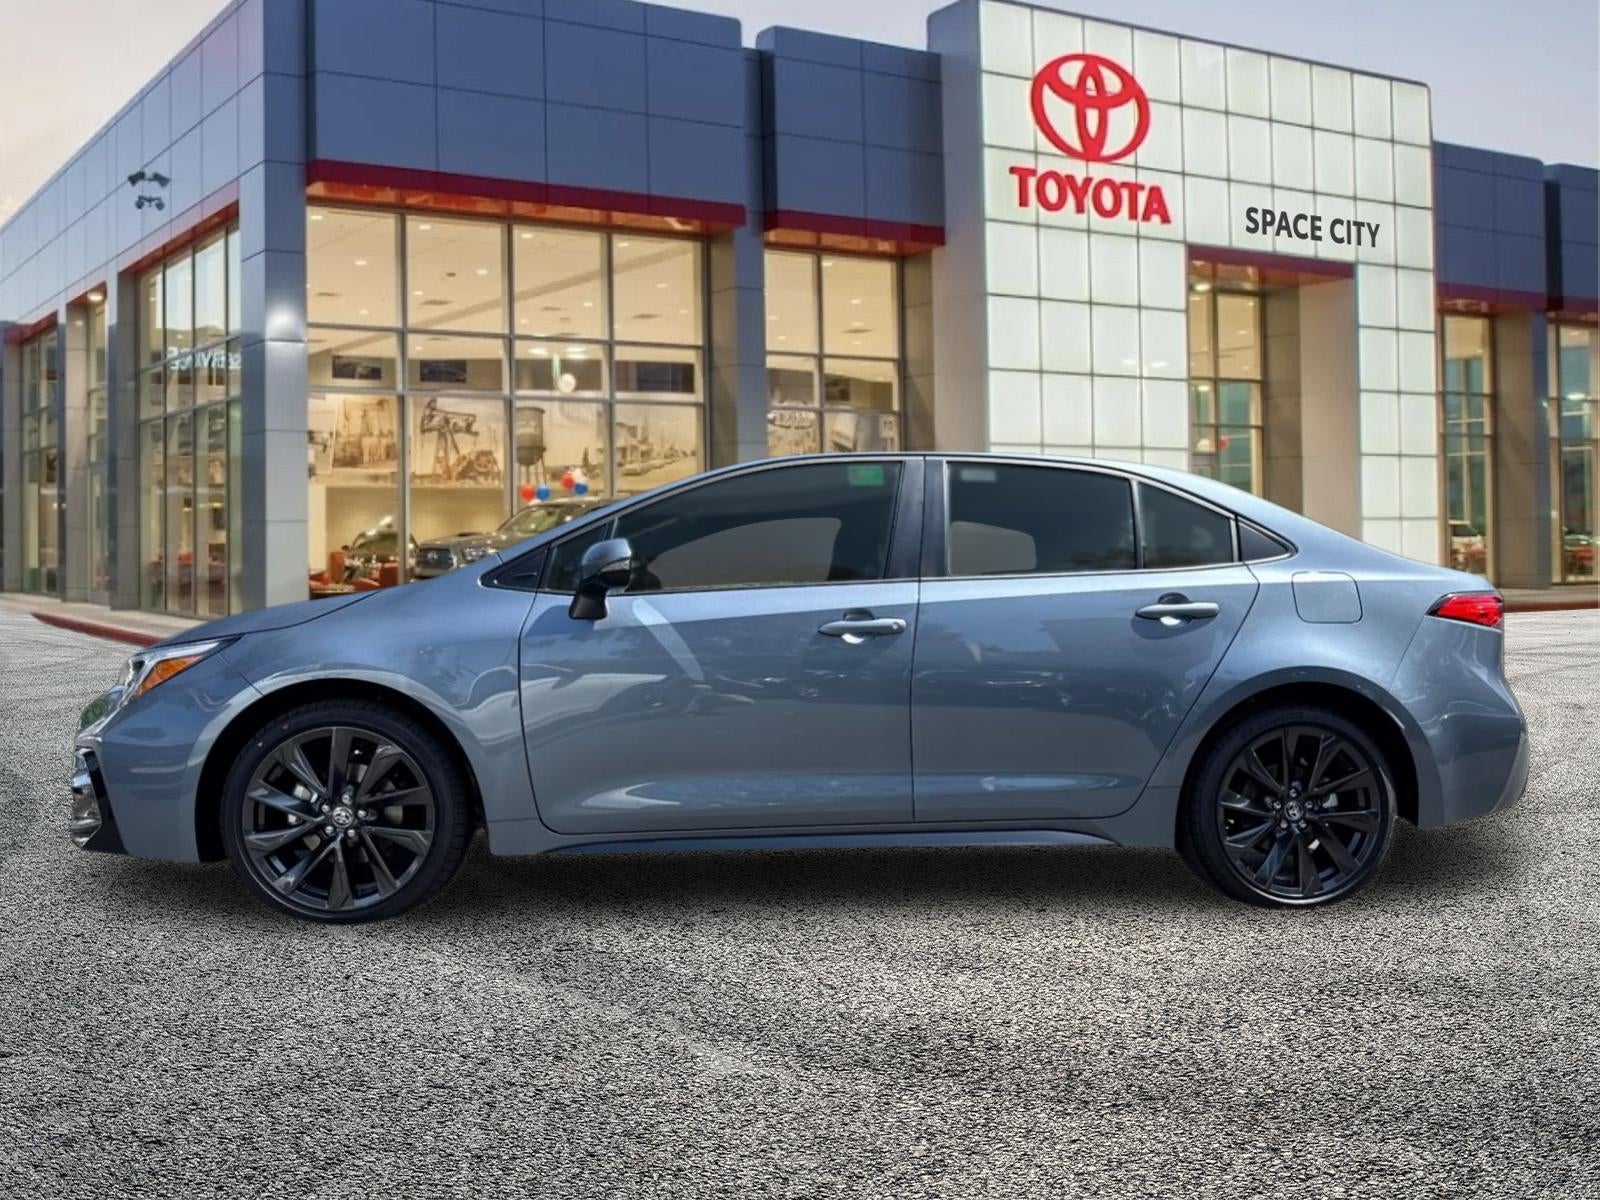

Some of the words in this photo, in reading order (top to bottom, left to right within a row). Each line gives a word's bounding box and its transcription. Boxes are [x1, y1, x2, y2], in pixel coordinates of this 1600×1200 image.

[1009, 166, 1171, 224] TOYOTA
[1245, 206, 1323, 242] SPACE
[1329, 217, 1381, 248] CITY
